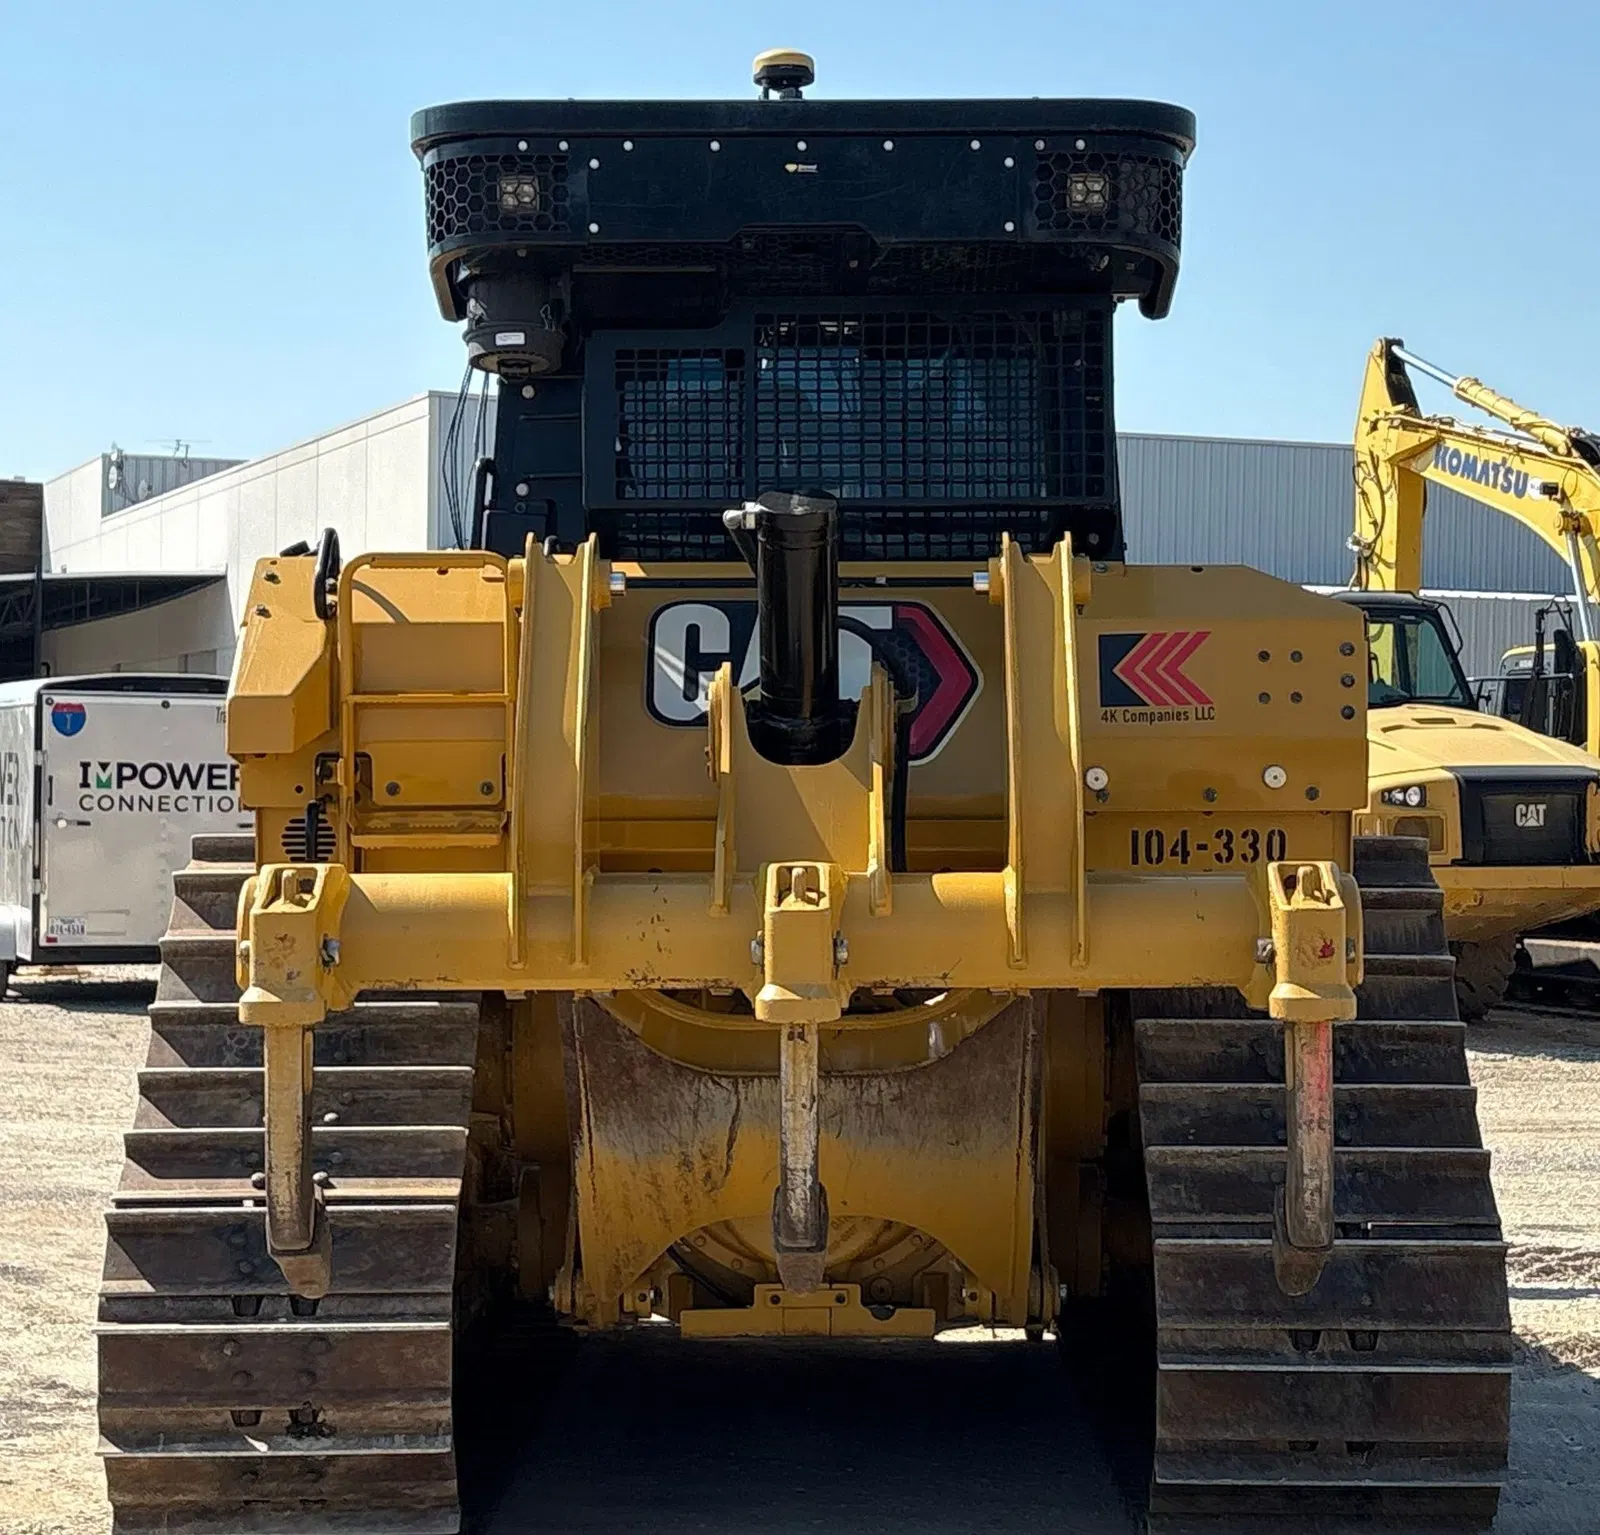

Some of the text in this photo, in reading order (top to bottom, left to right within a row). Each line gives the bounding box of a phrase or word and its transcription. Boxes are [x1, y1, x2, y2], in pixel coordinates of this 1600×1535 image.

[1433, 444, 1529, 499] KOMATSU
[654, 603, 893, 721] CT
[1101, 706, 1216, 725] 4K Companies LLC
[79, 794, 243, 813] CONNECTIO
[1515, 803, 1547, 827] CAT
[1131, 828, 1287, 866] 104-330
